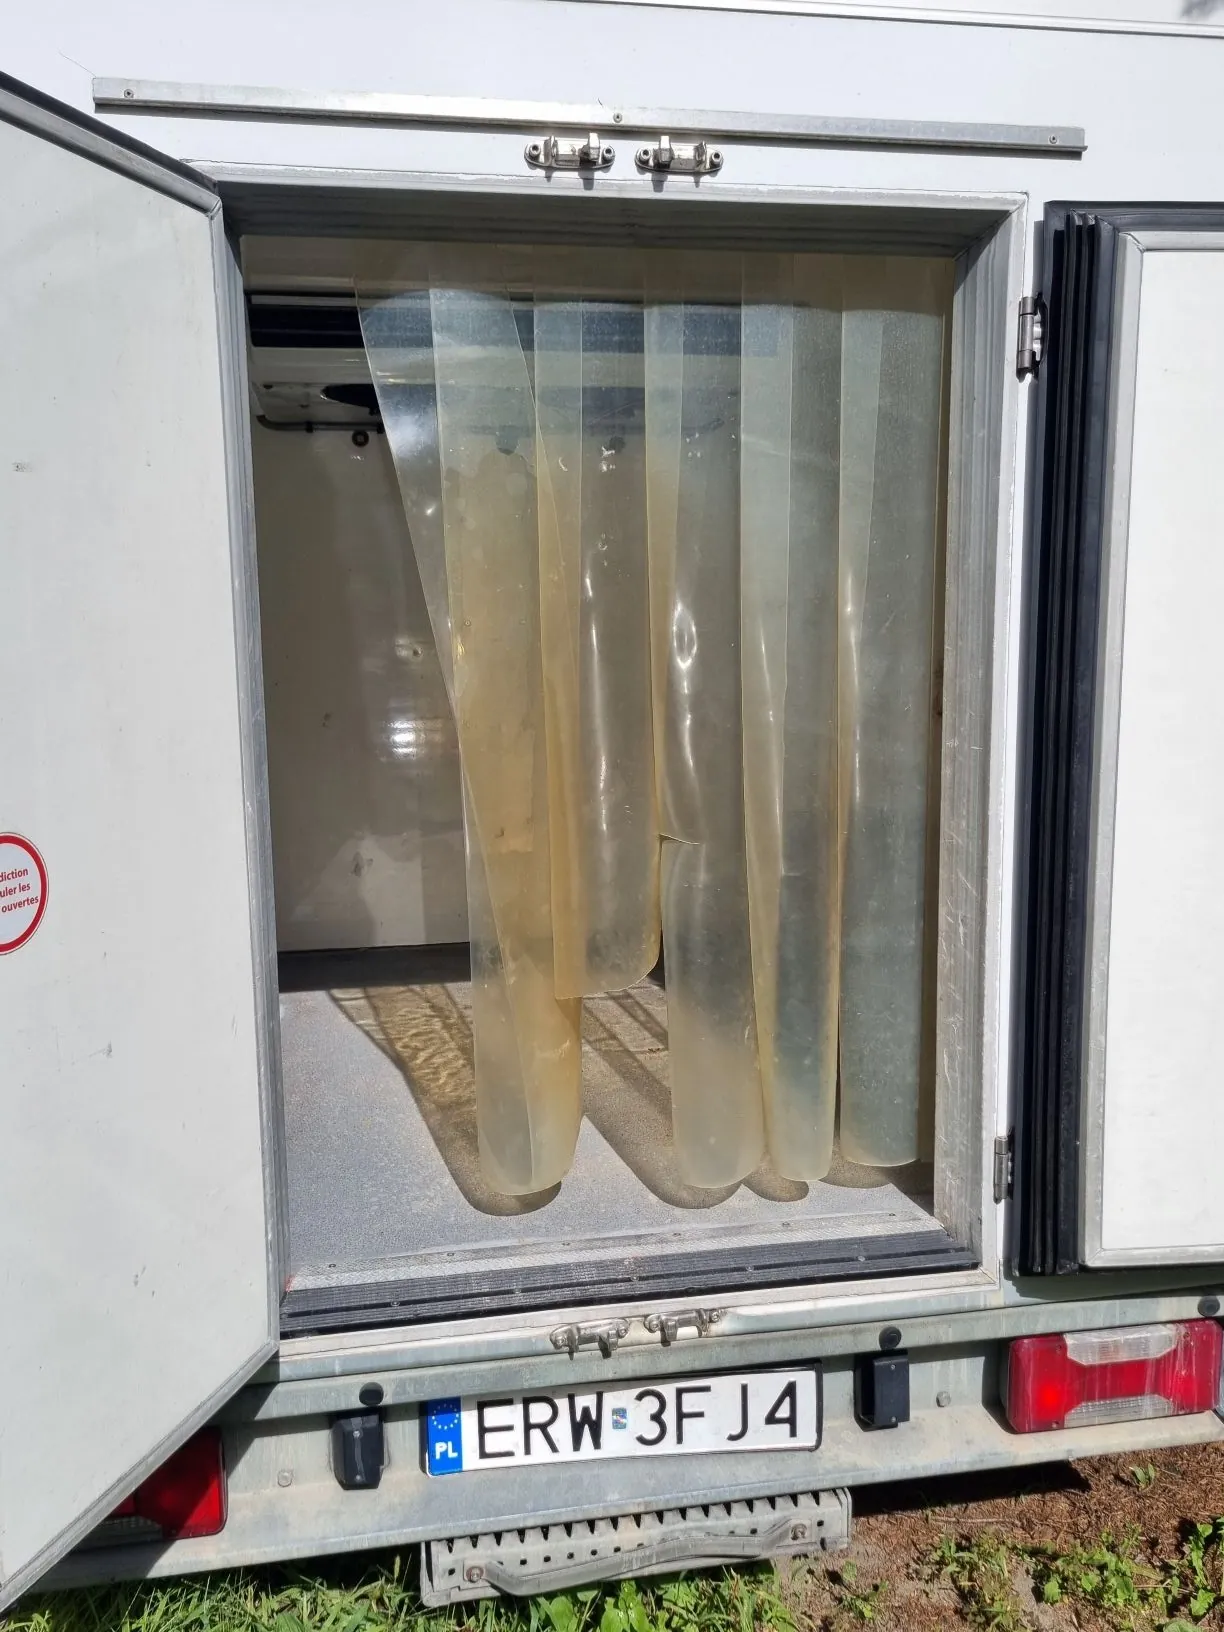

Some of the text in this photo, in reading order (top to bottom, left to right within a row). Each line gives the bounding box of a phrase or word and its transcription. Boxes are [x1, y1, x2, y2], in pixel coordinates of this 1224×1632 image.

[18, 883, 31, 893] les
[1, 896, 39, 913] ouvertes
[477, 1380, 798, 1460] ERW 3FJ4
[435, 1441, 459, 1460] PL
